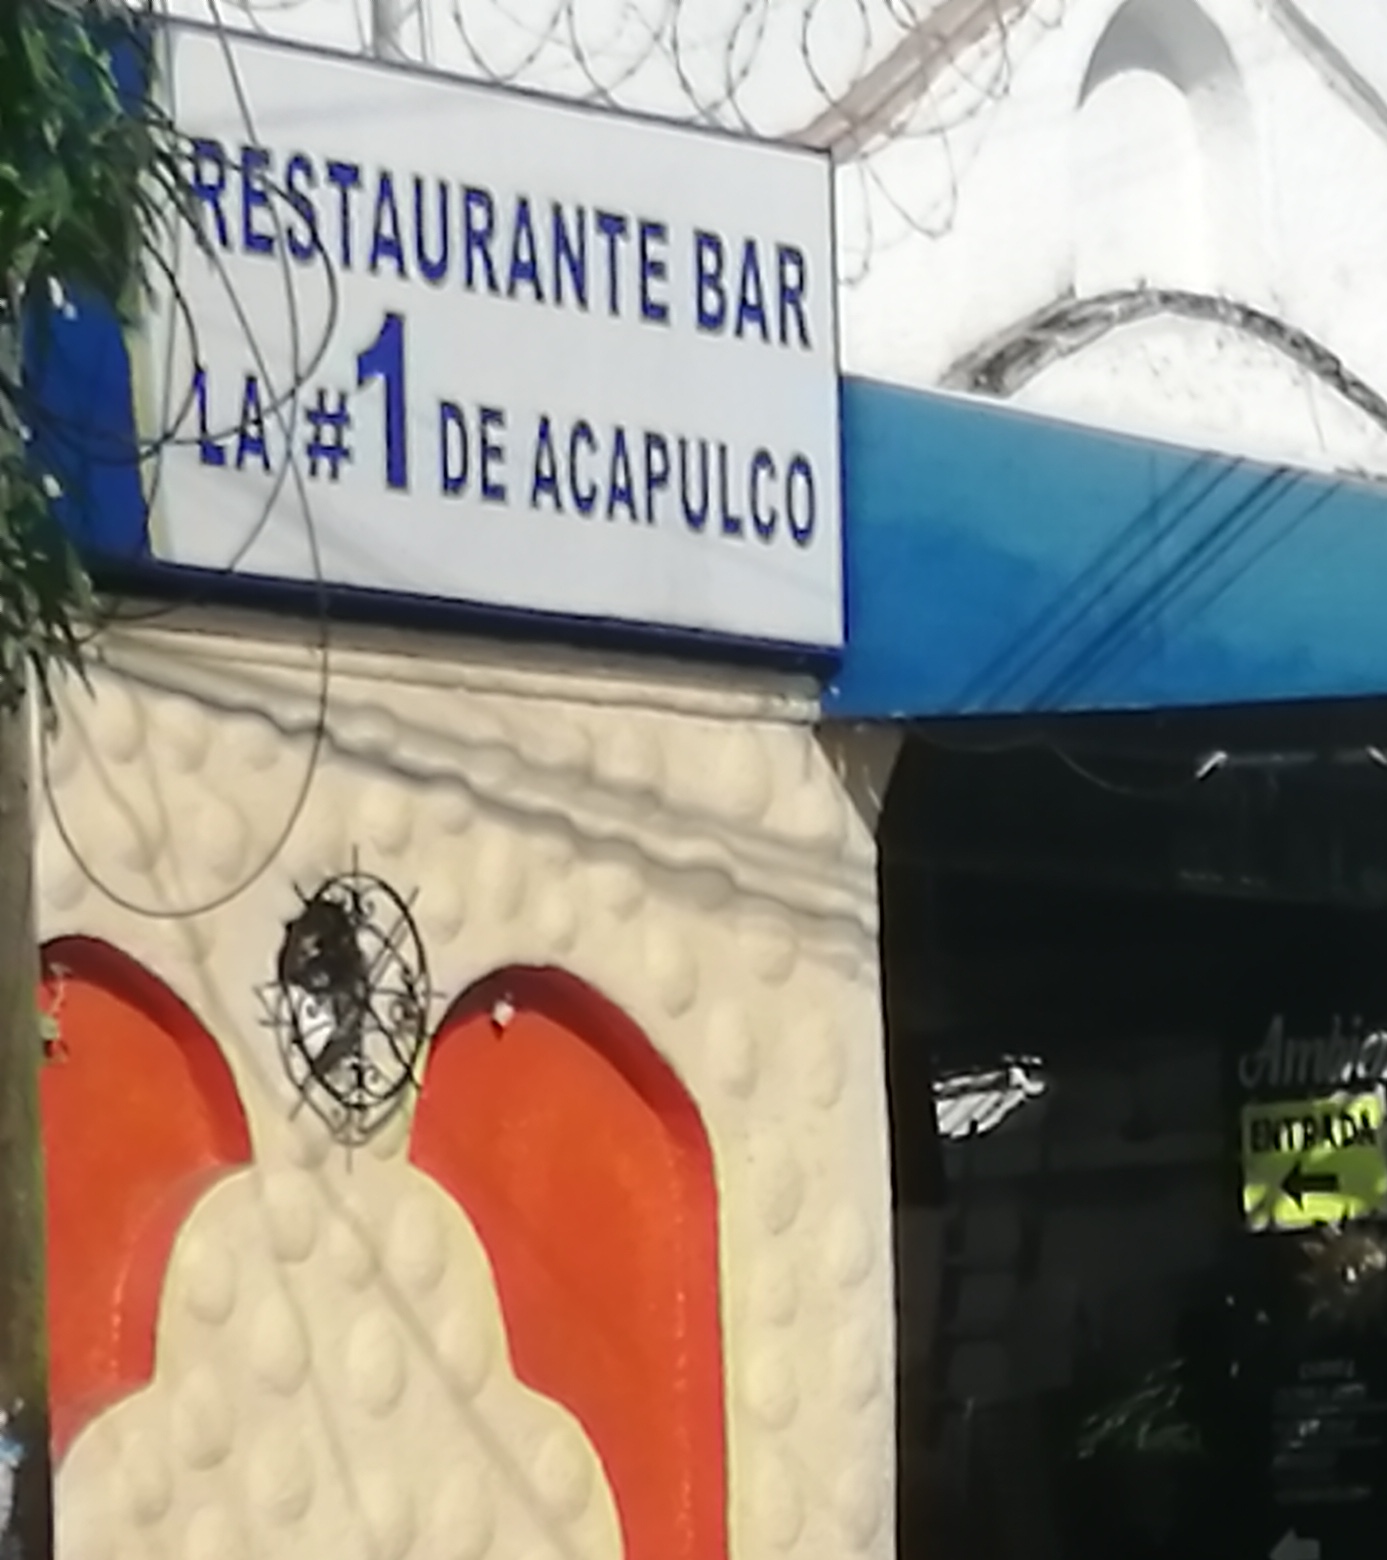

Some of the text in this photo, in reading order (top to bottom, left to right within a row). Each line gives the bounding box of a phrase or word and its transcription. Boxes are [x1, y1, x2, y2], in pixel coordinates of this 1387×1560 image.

[190, 138, 813, 351] RESTAURANTE BAR
[192, 310, 818, 549] LA #1 DE ACAPULCO
[1250, 1107, 1377, 1153] ENTRADA
